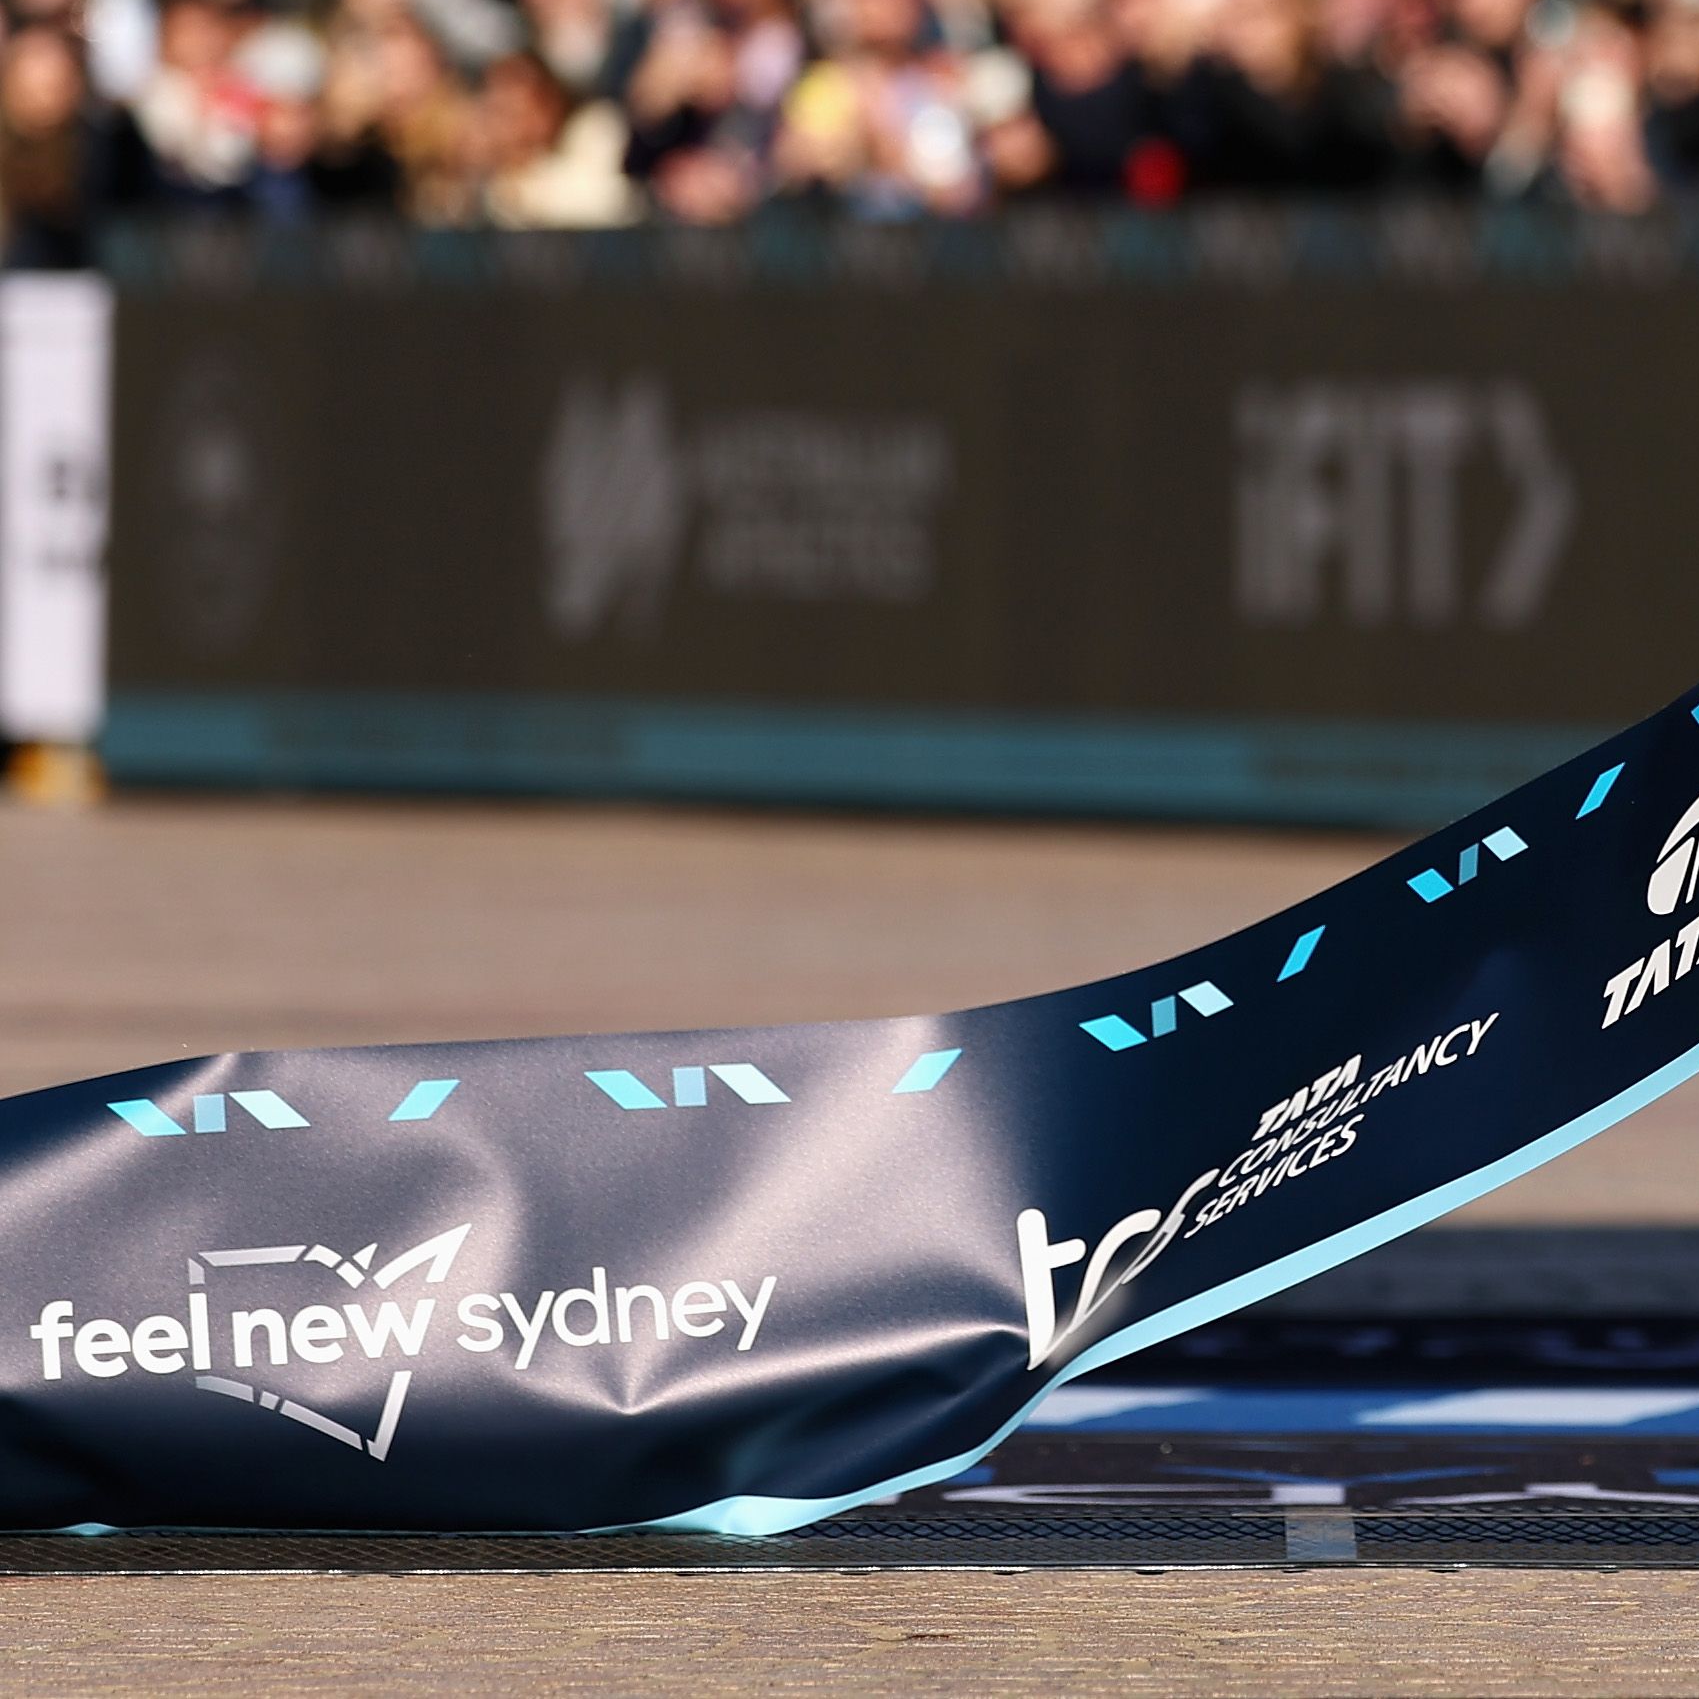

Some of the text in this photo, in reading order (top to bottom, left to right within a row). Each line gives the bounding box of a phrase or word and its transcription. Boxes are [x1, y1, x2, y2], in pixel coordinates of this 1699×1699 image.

[1218, 1012, 1499, 1188] CONSULTANCY
[1252, 1054, 1362, 1141] TATA
[1184, 1113, 1365, 1239] SERVICES
[30, 1267, 778, 1381] feel new sydney
